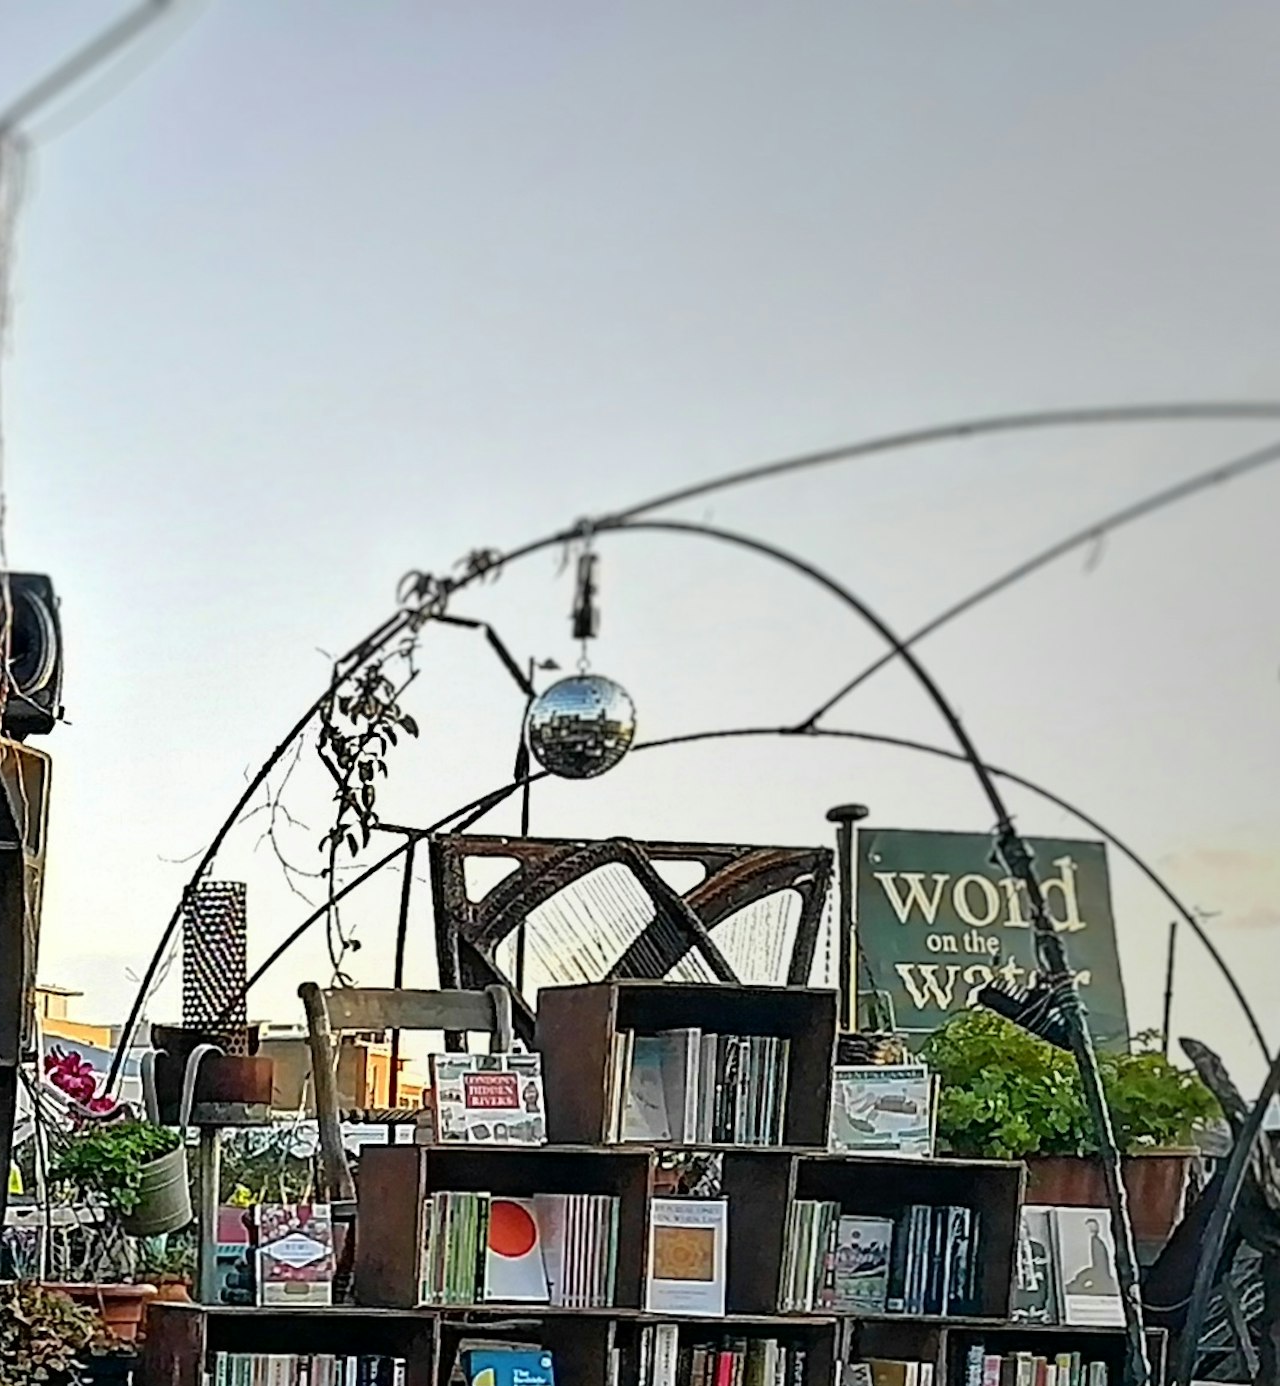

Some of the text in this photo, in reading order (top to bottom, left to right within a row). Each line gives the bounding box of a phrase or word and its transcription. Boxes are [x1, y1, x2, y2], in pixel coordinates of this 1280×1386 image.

[873, 855, 1087, 932] word
[926, 929, 1001, 954] on the
[895, 956, 1091, 1011] watr
